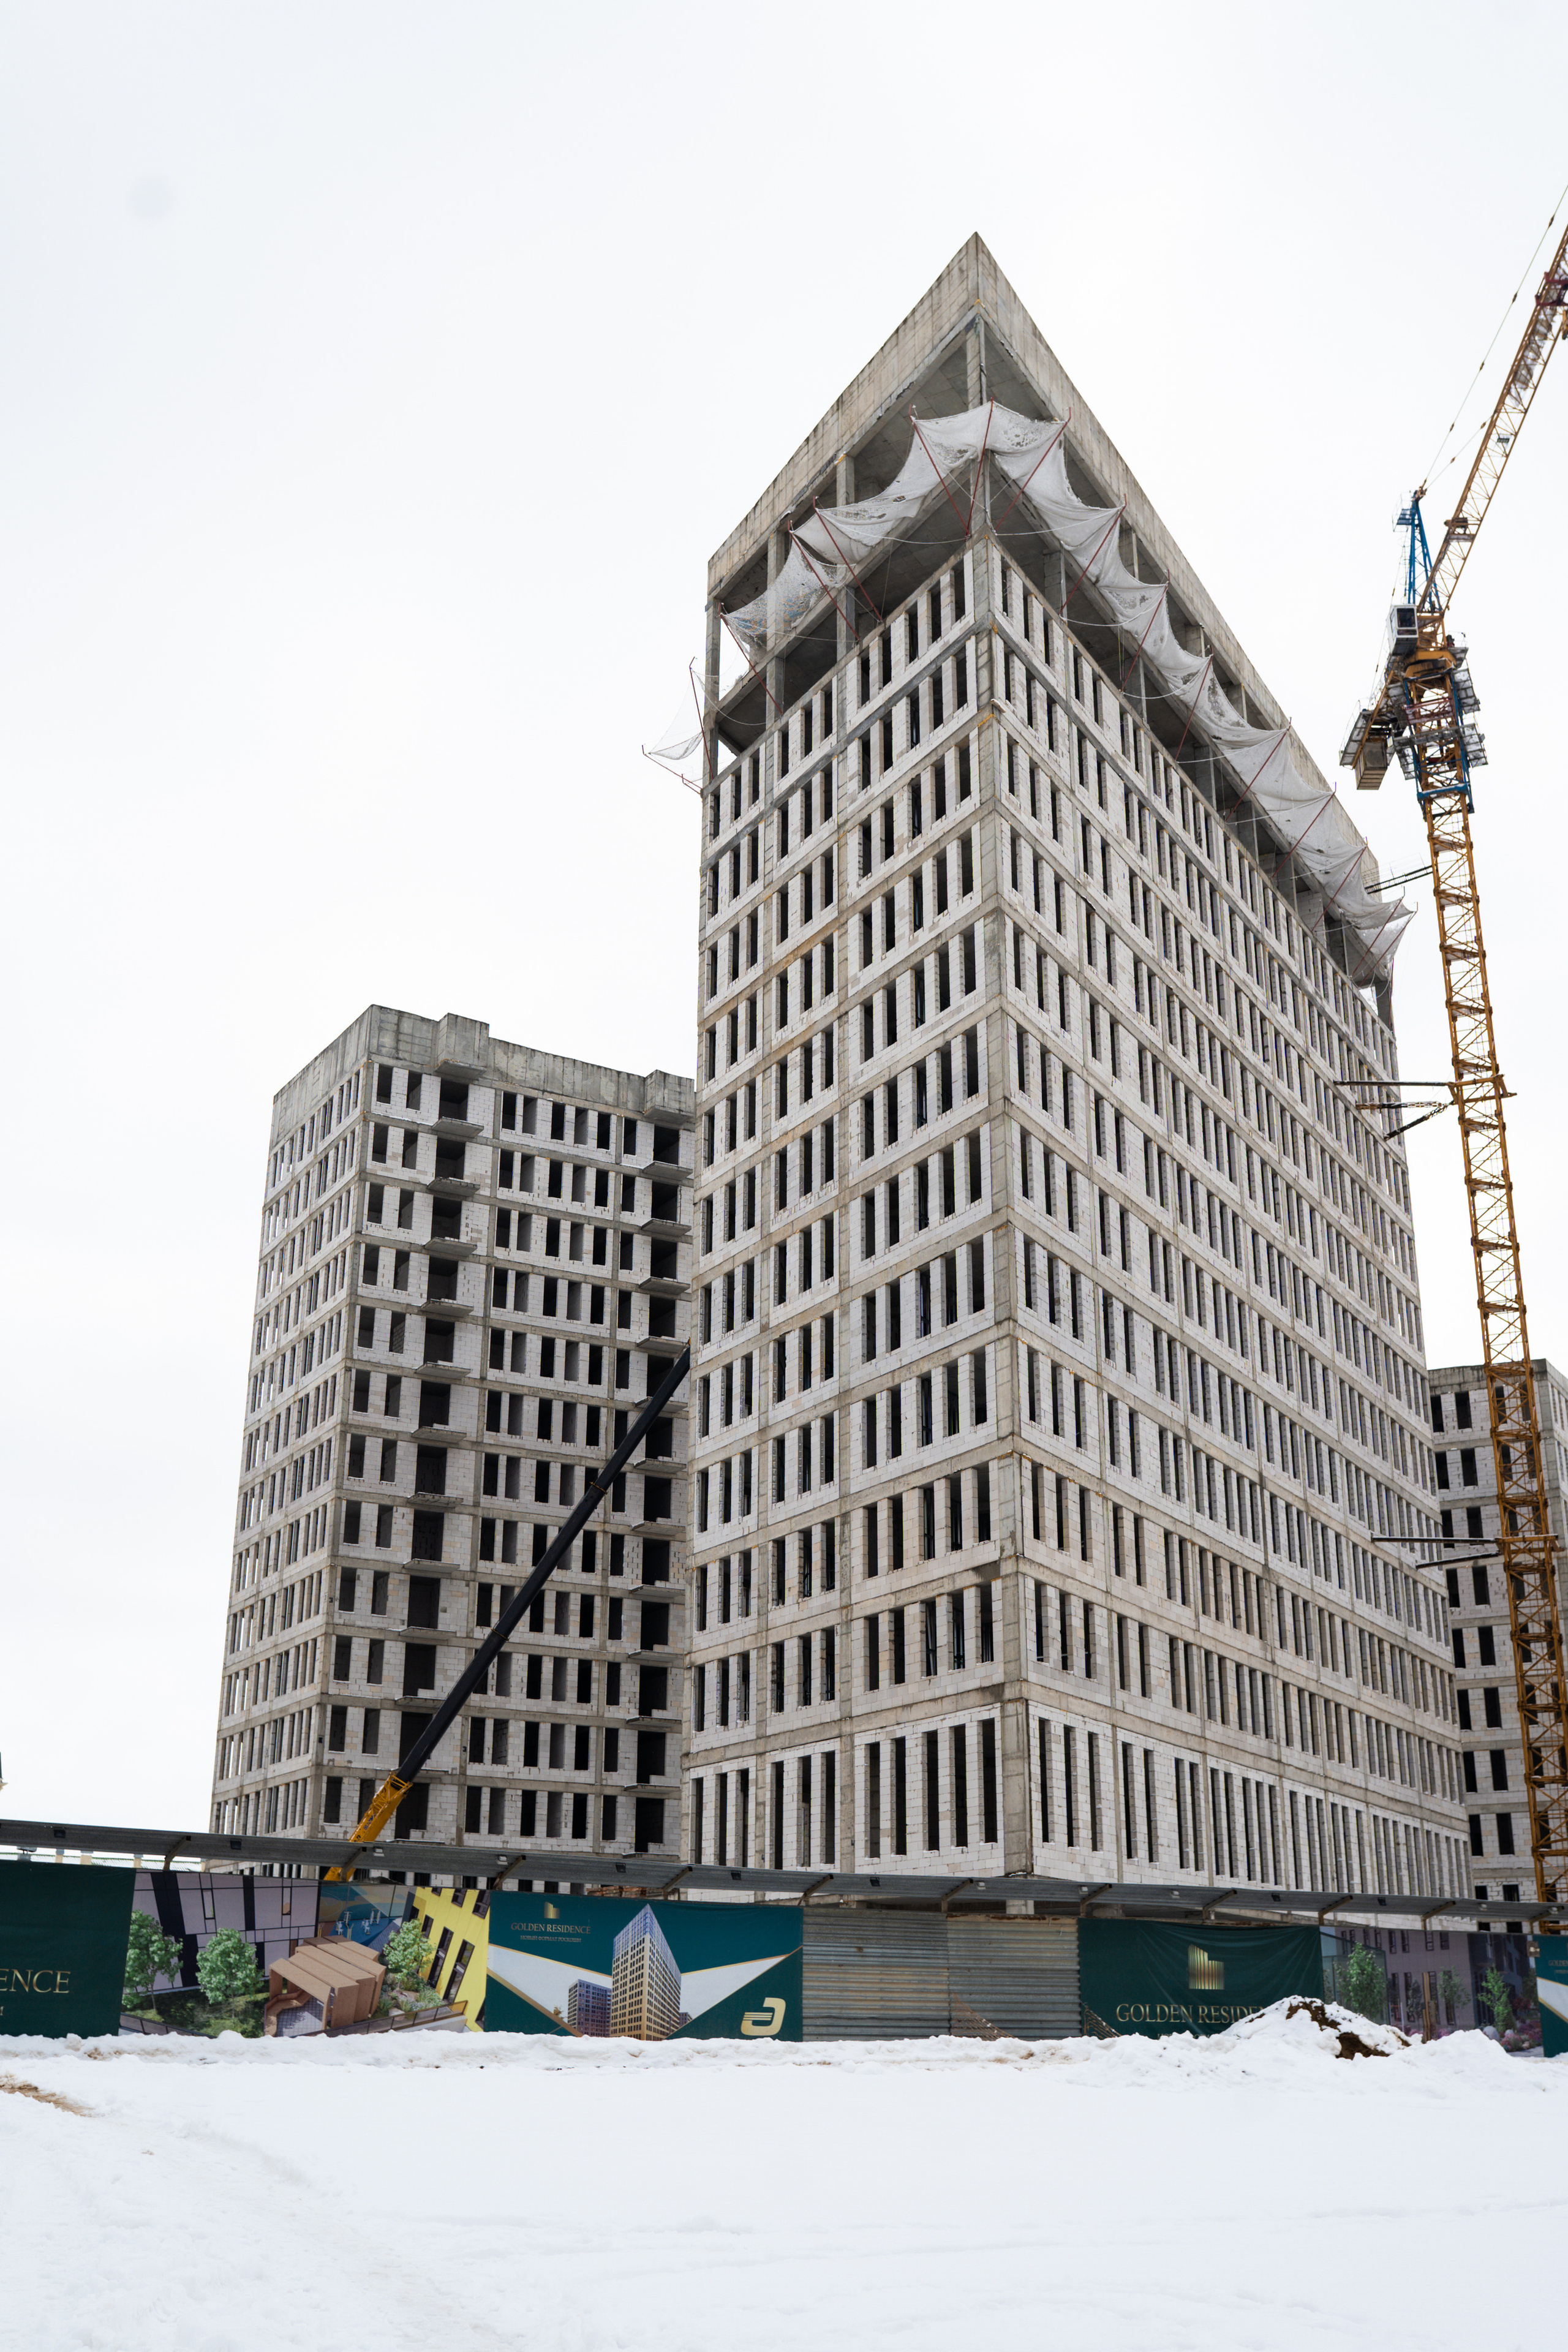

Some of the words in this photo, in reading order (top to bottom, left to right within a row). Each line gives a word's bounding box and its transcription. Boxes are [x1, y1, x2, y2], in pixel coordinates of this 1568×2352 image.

[511, 1923, 545, 1931] GOLDEN
[547, 1924, 591, 1934] RESIDENCE
[1116, 2003, 1193, 2022] GOLDEN
